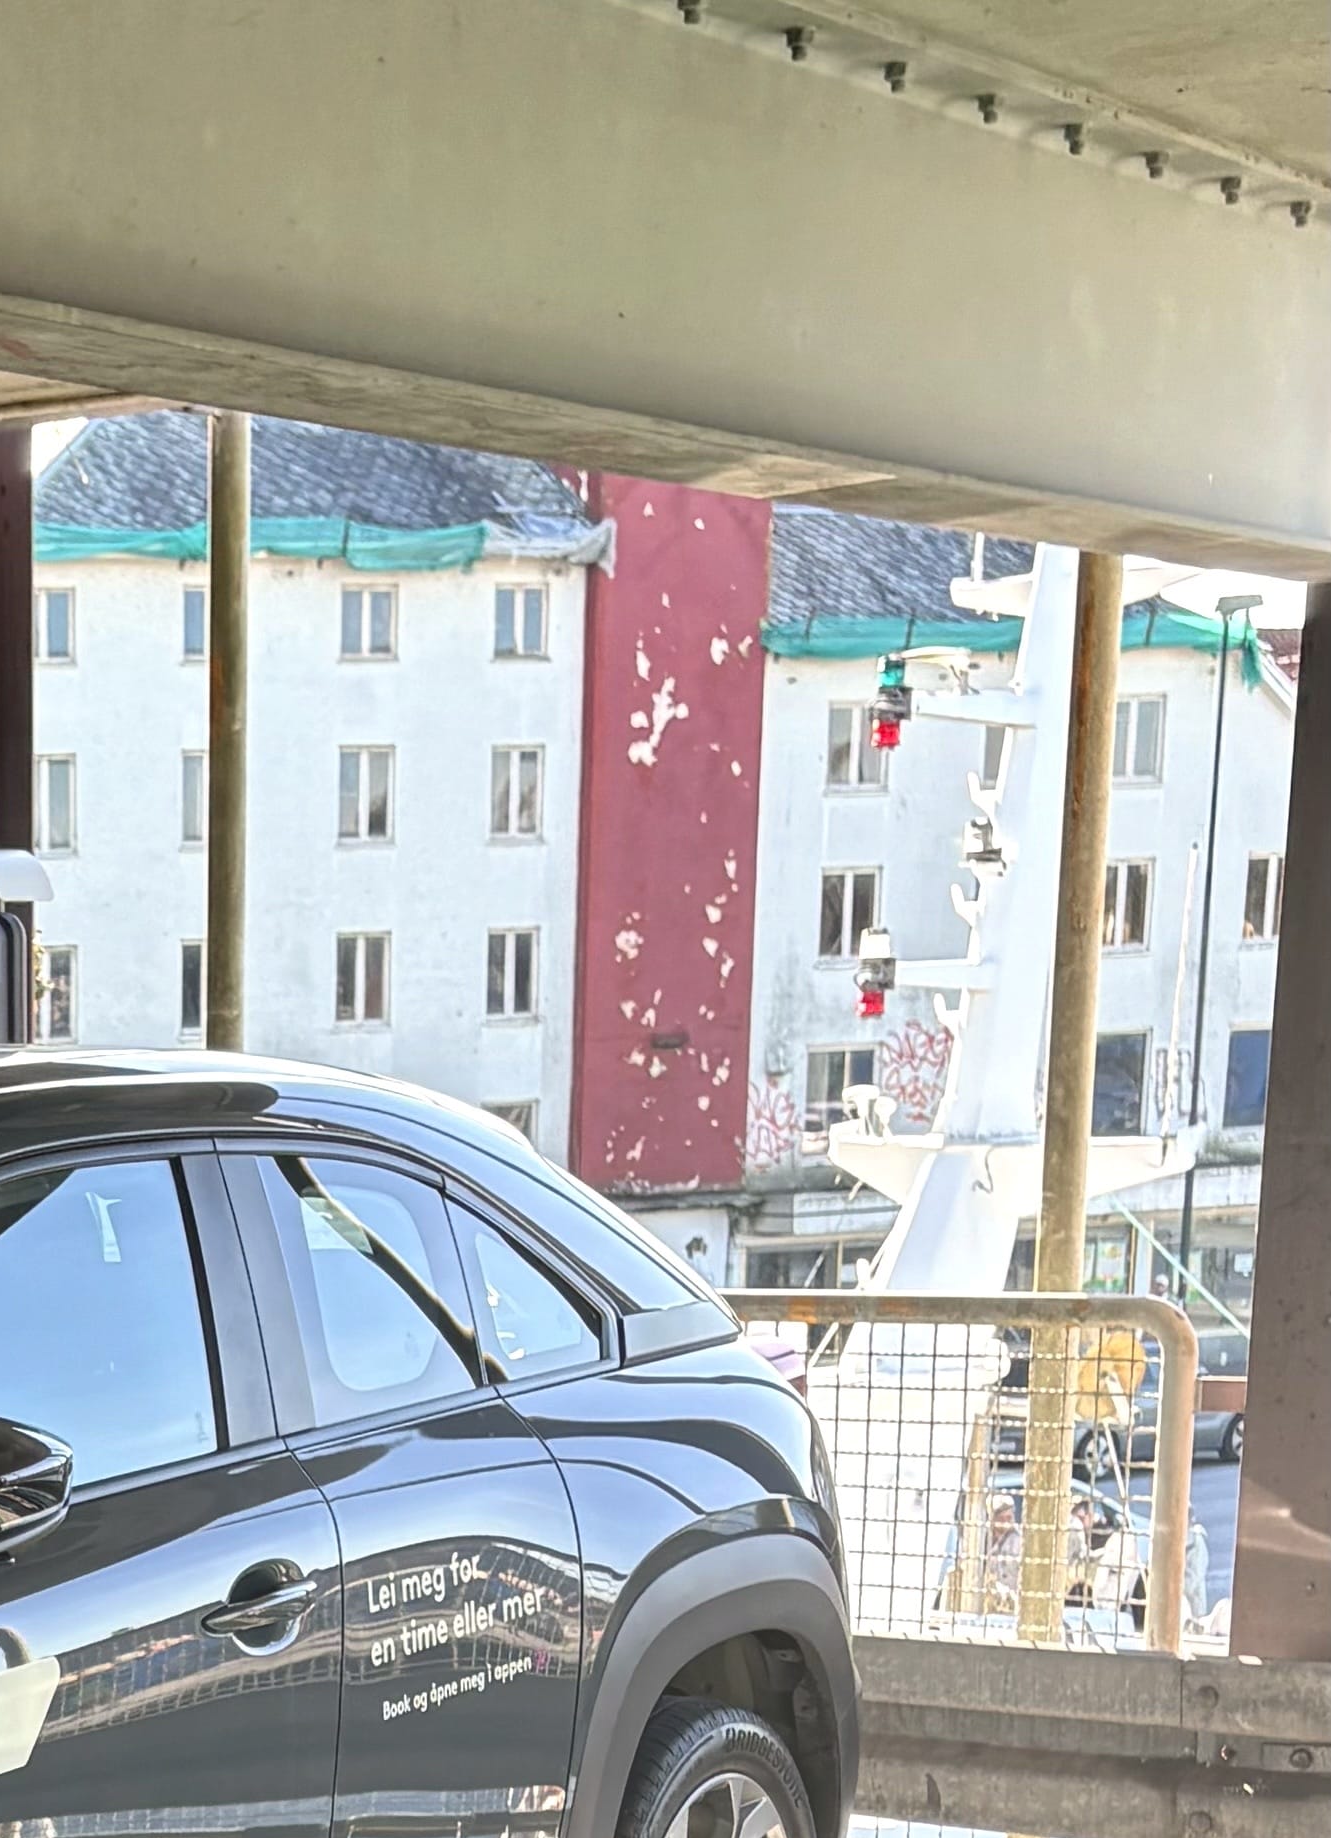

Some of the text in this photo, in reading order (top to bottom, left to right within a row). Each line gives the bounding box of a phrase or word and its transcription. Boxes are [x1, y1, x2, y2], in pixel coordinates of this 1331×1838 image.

[367, 1552, 480, 1613] Lei meg for
[370, 1587, 546, 1667] en time eller mer
[383, 1694, 410, 1721] Book
[413, 1692, 428, 1712] og
[430, 1682, 458, 1706] åpne
[460, 1670, 485, 1692] meg
[487, 1663, 492, 1683] i
